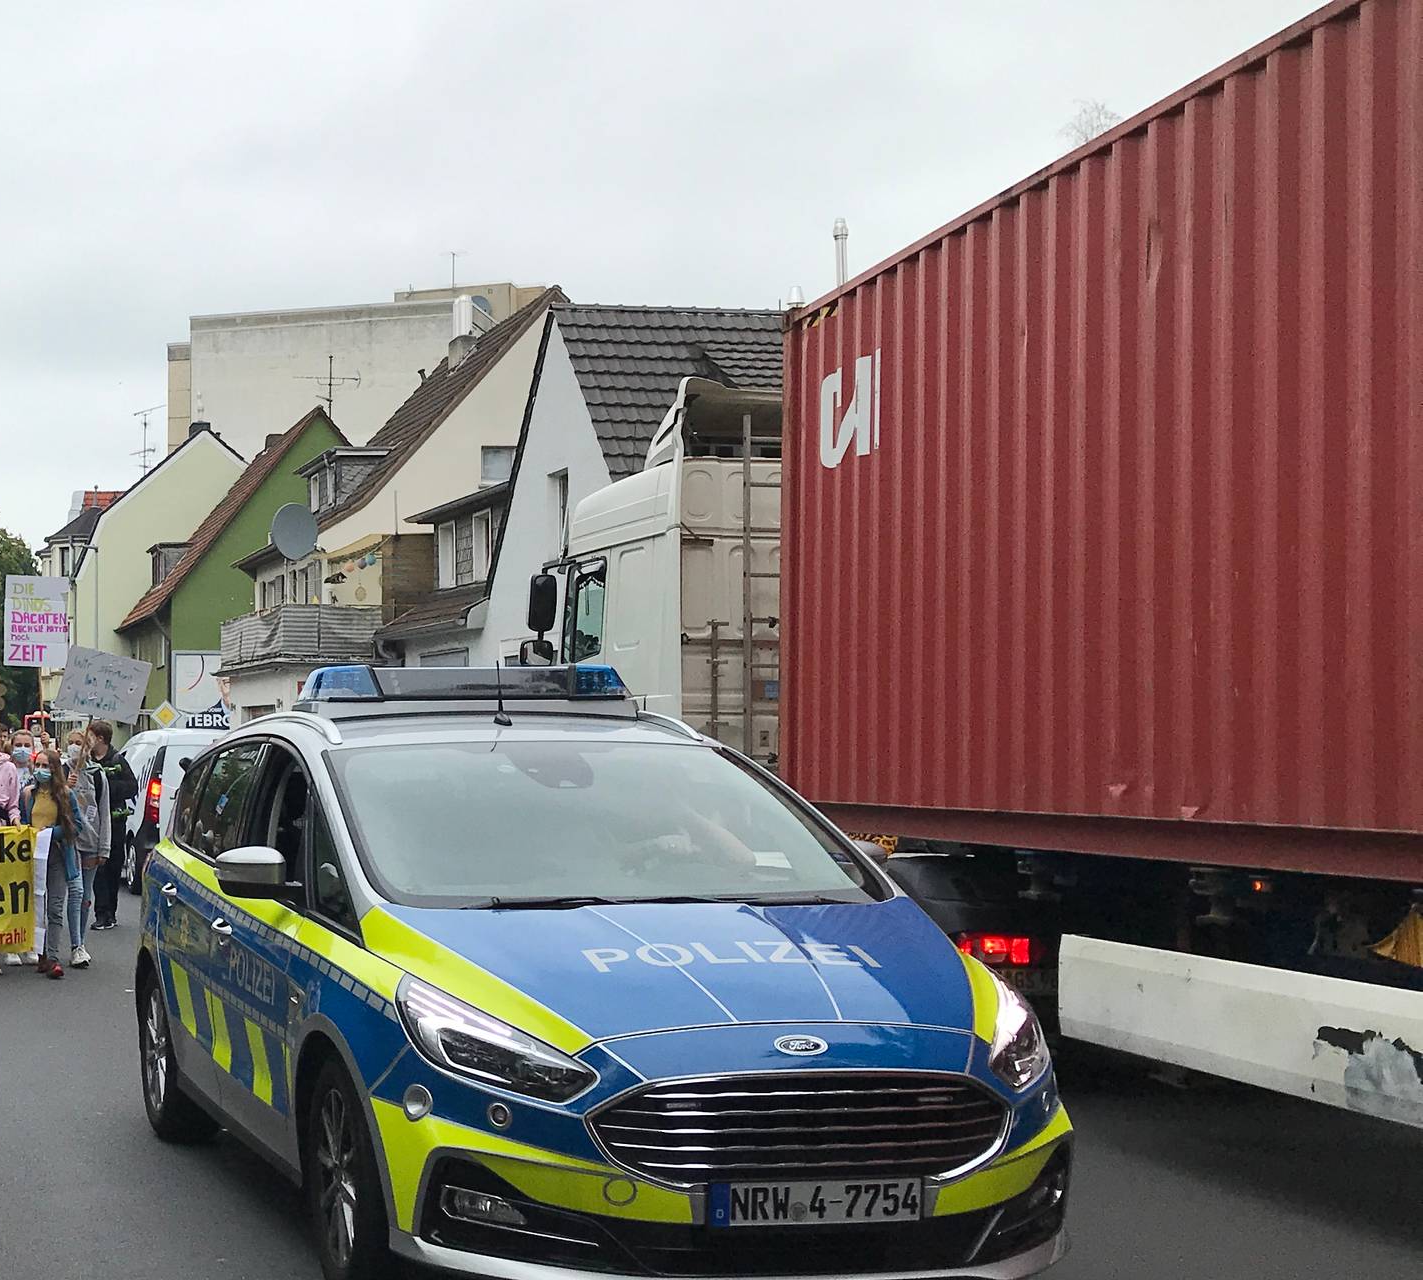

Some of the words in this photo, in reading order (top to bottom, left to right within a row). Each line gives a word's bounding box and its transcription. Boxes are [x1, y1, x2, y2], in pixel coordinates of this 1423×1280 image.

[820, 347, 881, 469] CAI
[12, 583, 34, 594] DIE
[11, 597, 53, 612] DINOS
[11, 611, 67, 624] DACHTEN
[8, 643, 47, 662] ZEIT
[187, 713, 230, 727] TEBRO
[581, 941, 882, 973] POLIZEI
[228, 944, 275, 1006] POLIZEI
[788, 1040, 815, 1050] Ford
[731, 1186, 791, 1221] NRW
[809, 1182, 919, 1219] 4-7754
